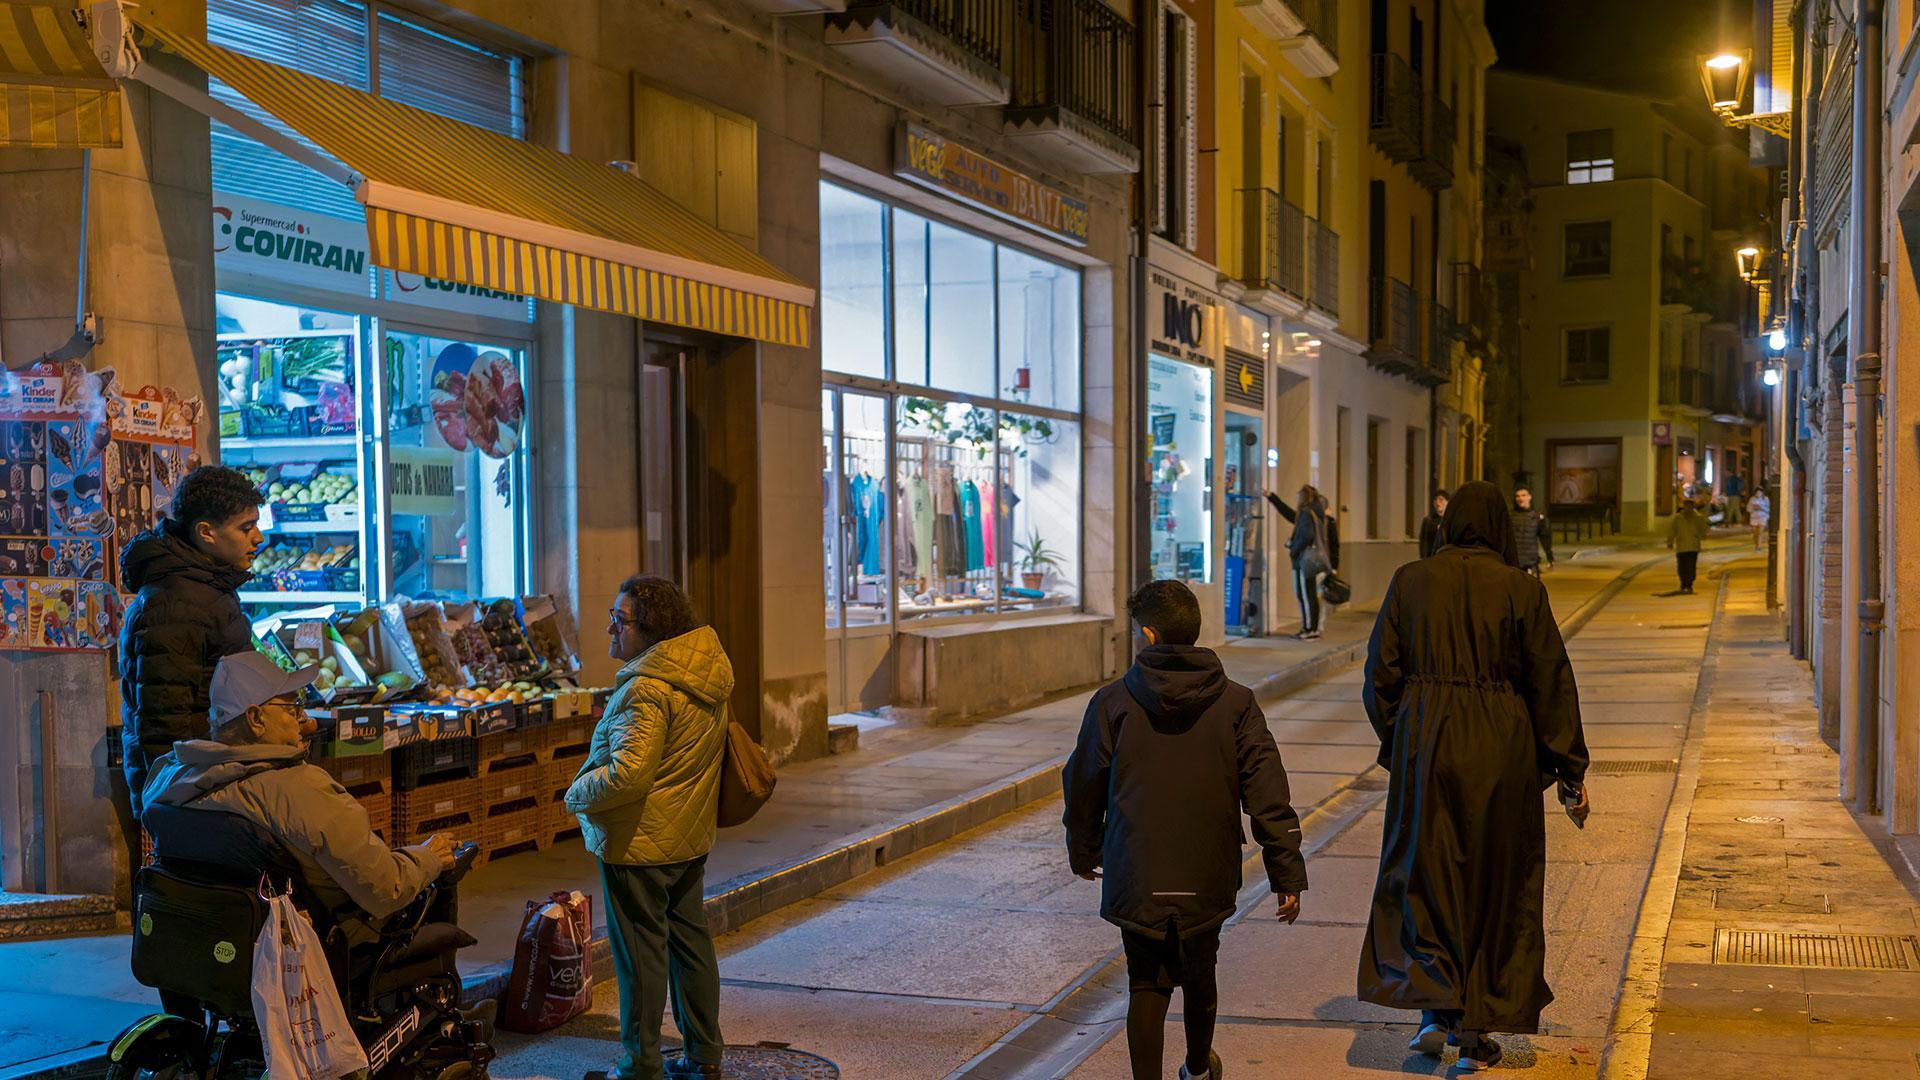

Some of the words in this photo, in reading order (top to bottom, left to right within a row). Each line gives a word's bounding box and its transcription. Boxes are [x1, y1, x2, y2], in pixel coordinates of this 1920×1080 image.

[235, 226, 365, 275] COVIRAN
[22, 384, 57, 397] Kinder
[132, 406, 158, 420] Kinder
[422, 464, 454, 497] NAVARRA
[216, 947, 234, 957] STOP
